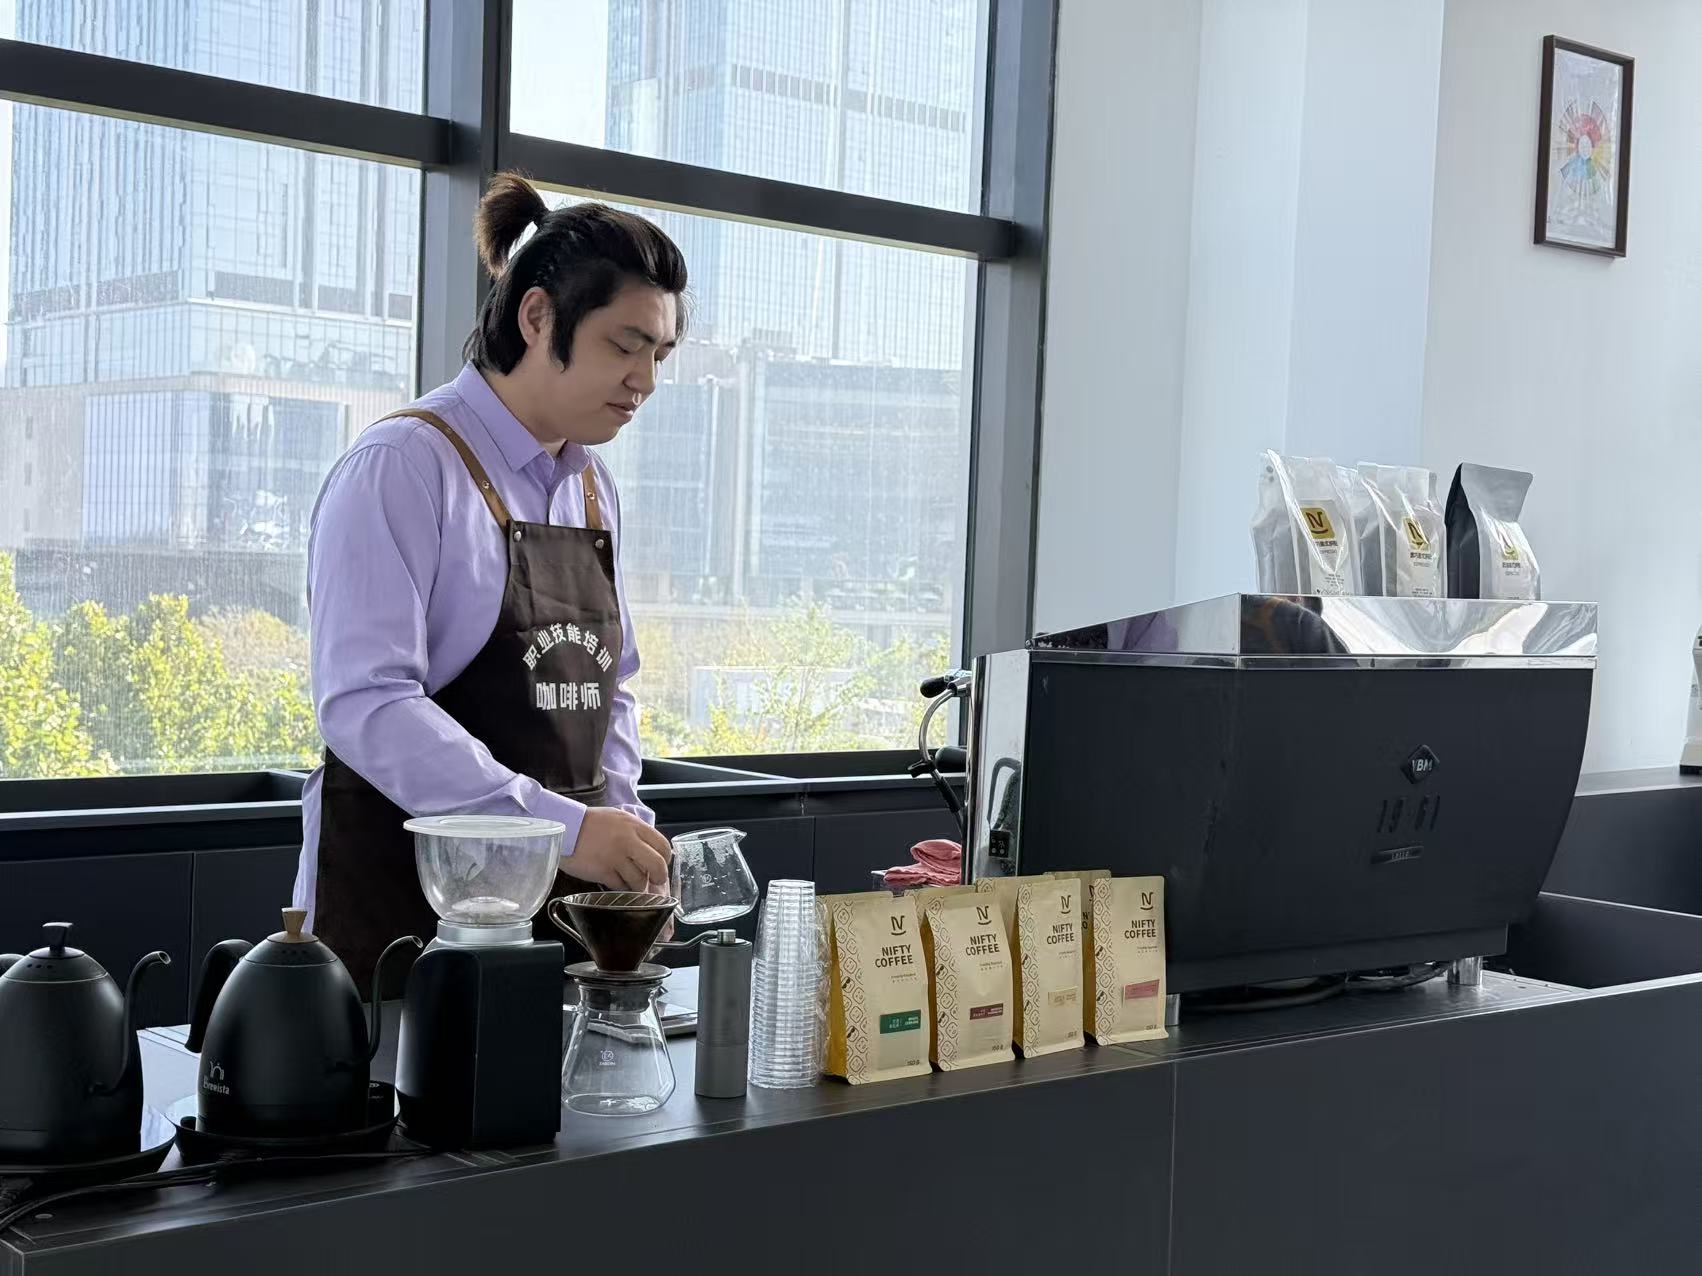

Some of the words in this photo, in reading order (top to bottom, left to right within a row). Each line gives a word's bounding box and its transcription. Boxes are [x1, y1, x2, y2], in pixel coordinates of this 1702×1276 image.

[522, 622, 613, 672] 职业技能培训
[536, 682, 601, 710] 咖啡师
[1052, 922, 1073, 934] NIFTY
[1131, 918, 1156, 929] NIFTY
[969, 933, 997, 945] NIFTY
[1046, 932, 1075, 945] COFFEE
[1124, 928, 1157, 939] COFFEE
[881, 944, 911, 957] NIFTY
[965, 943, 1000, 956] COFFEE
[875, 954, 914, 968] COFFEE
